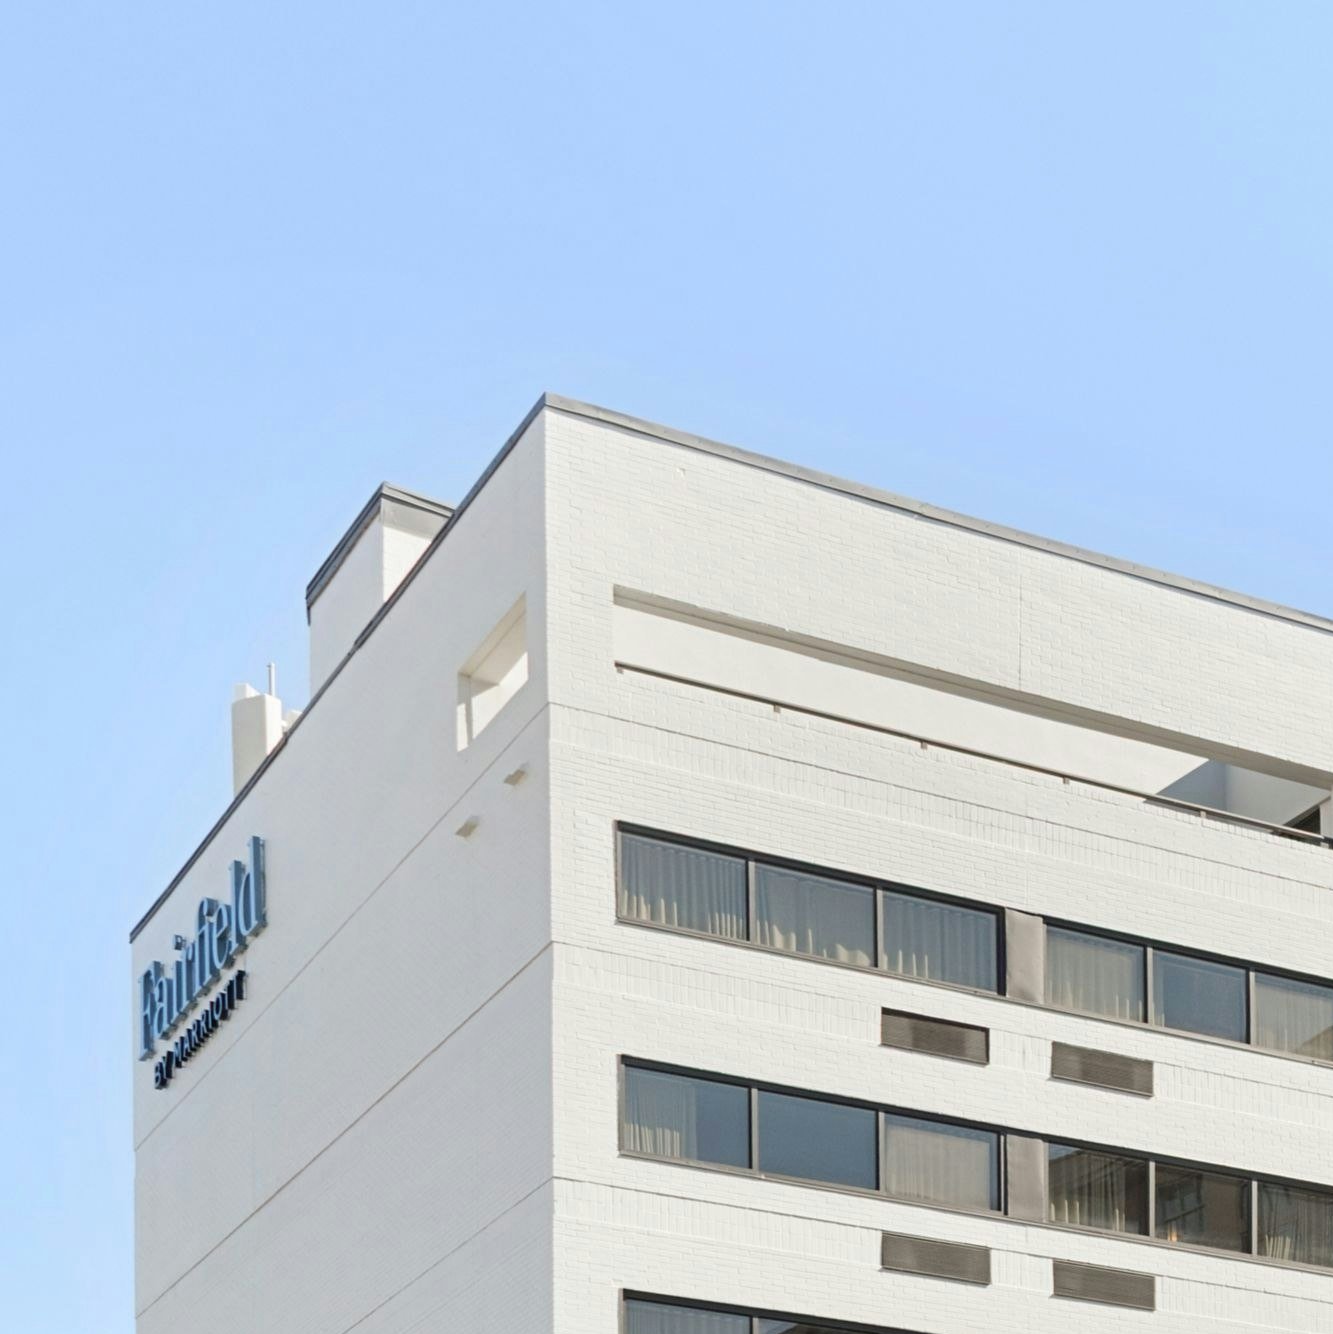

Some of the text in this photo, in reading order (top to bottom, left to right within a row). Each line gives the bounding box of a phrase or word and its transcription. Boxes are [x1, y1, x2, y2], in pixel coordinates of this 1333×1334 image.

[139, 836, 267, 1061] Fairfield
[154, 969, 246, 1090] BY MARRIOTT
